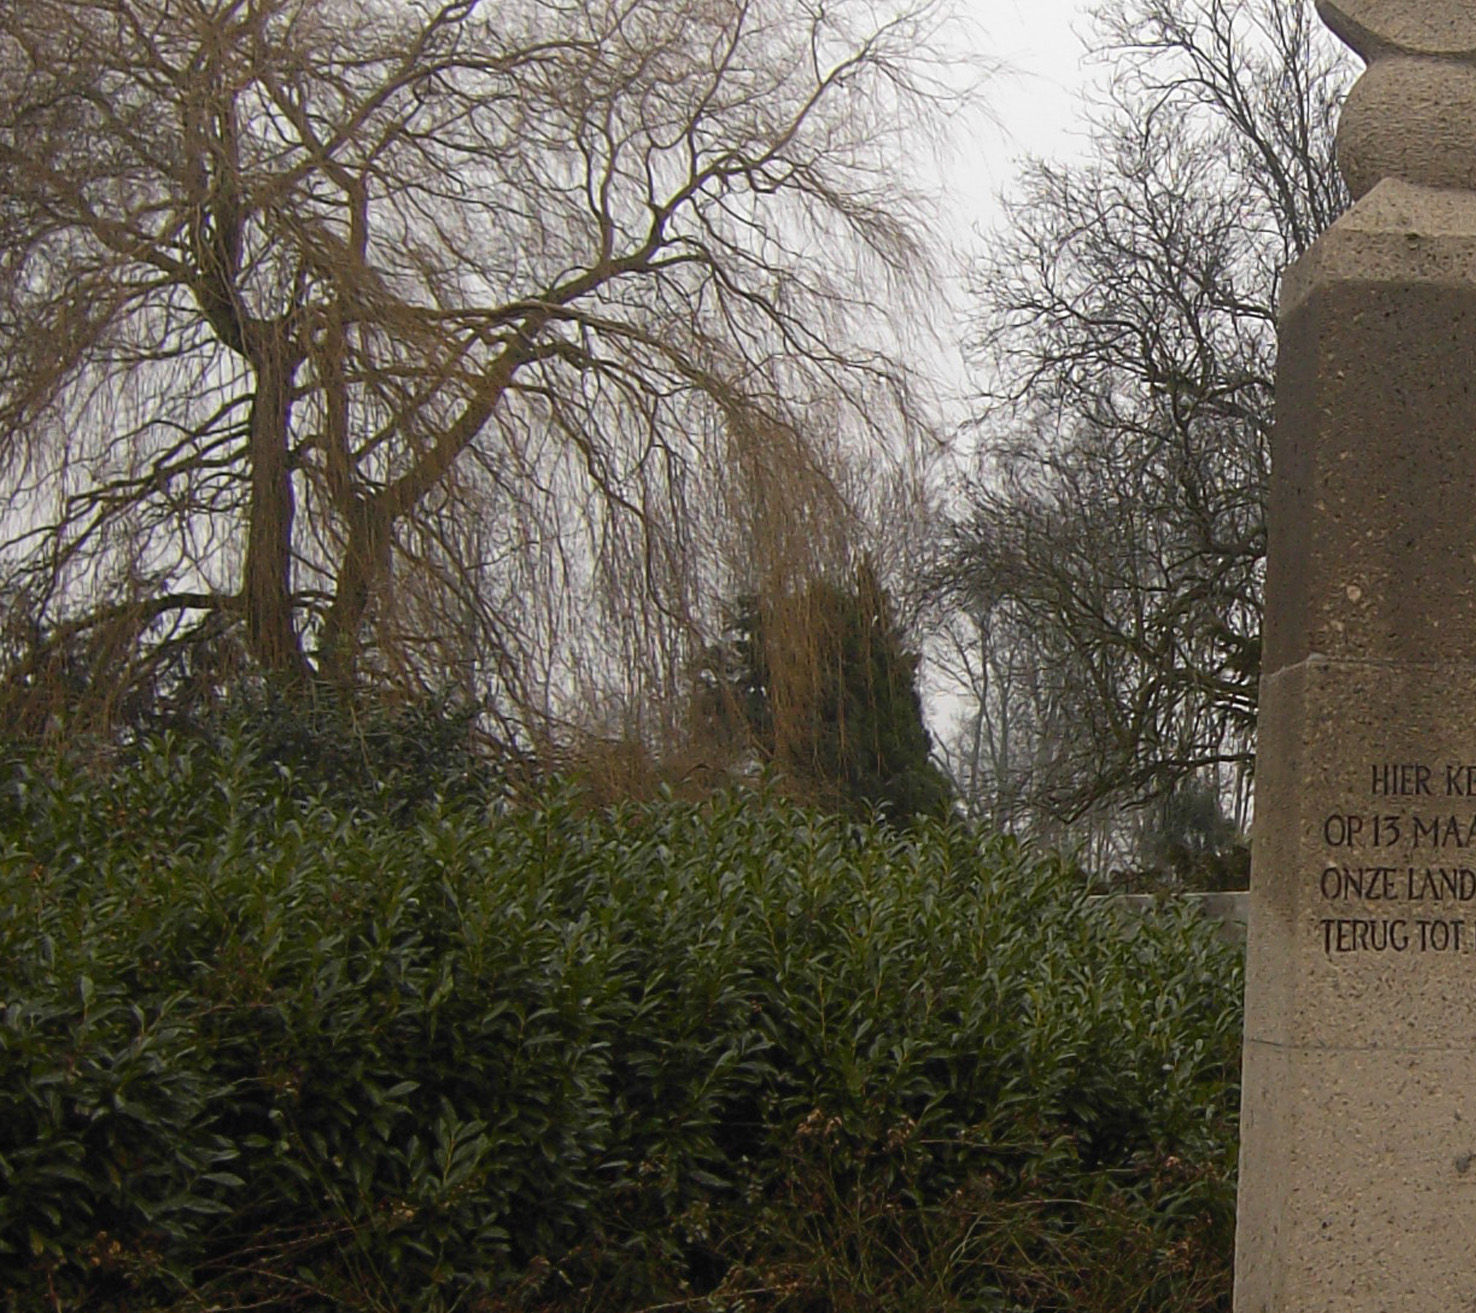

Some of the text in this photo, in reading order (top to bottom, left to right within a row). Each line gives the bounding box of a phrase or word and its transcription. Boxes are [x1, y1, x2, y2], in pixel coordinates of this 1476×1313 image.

[1372, 764, 1432, 797] HIER
[1324, 815, 1363, 847] OP
[1372, 815, 1400, 847] 13
[1320, 867, 1398, 900] ONZE
[1321, 919, 1409, 954] TERUG
[1416, 920, 1464, 952] TOT
